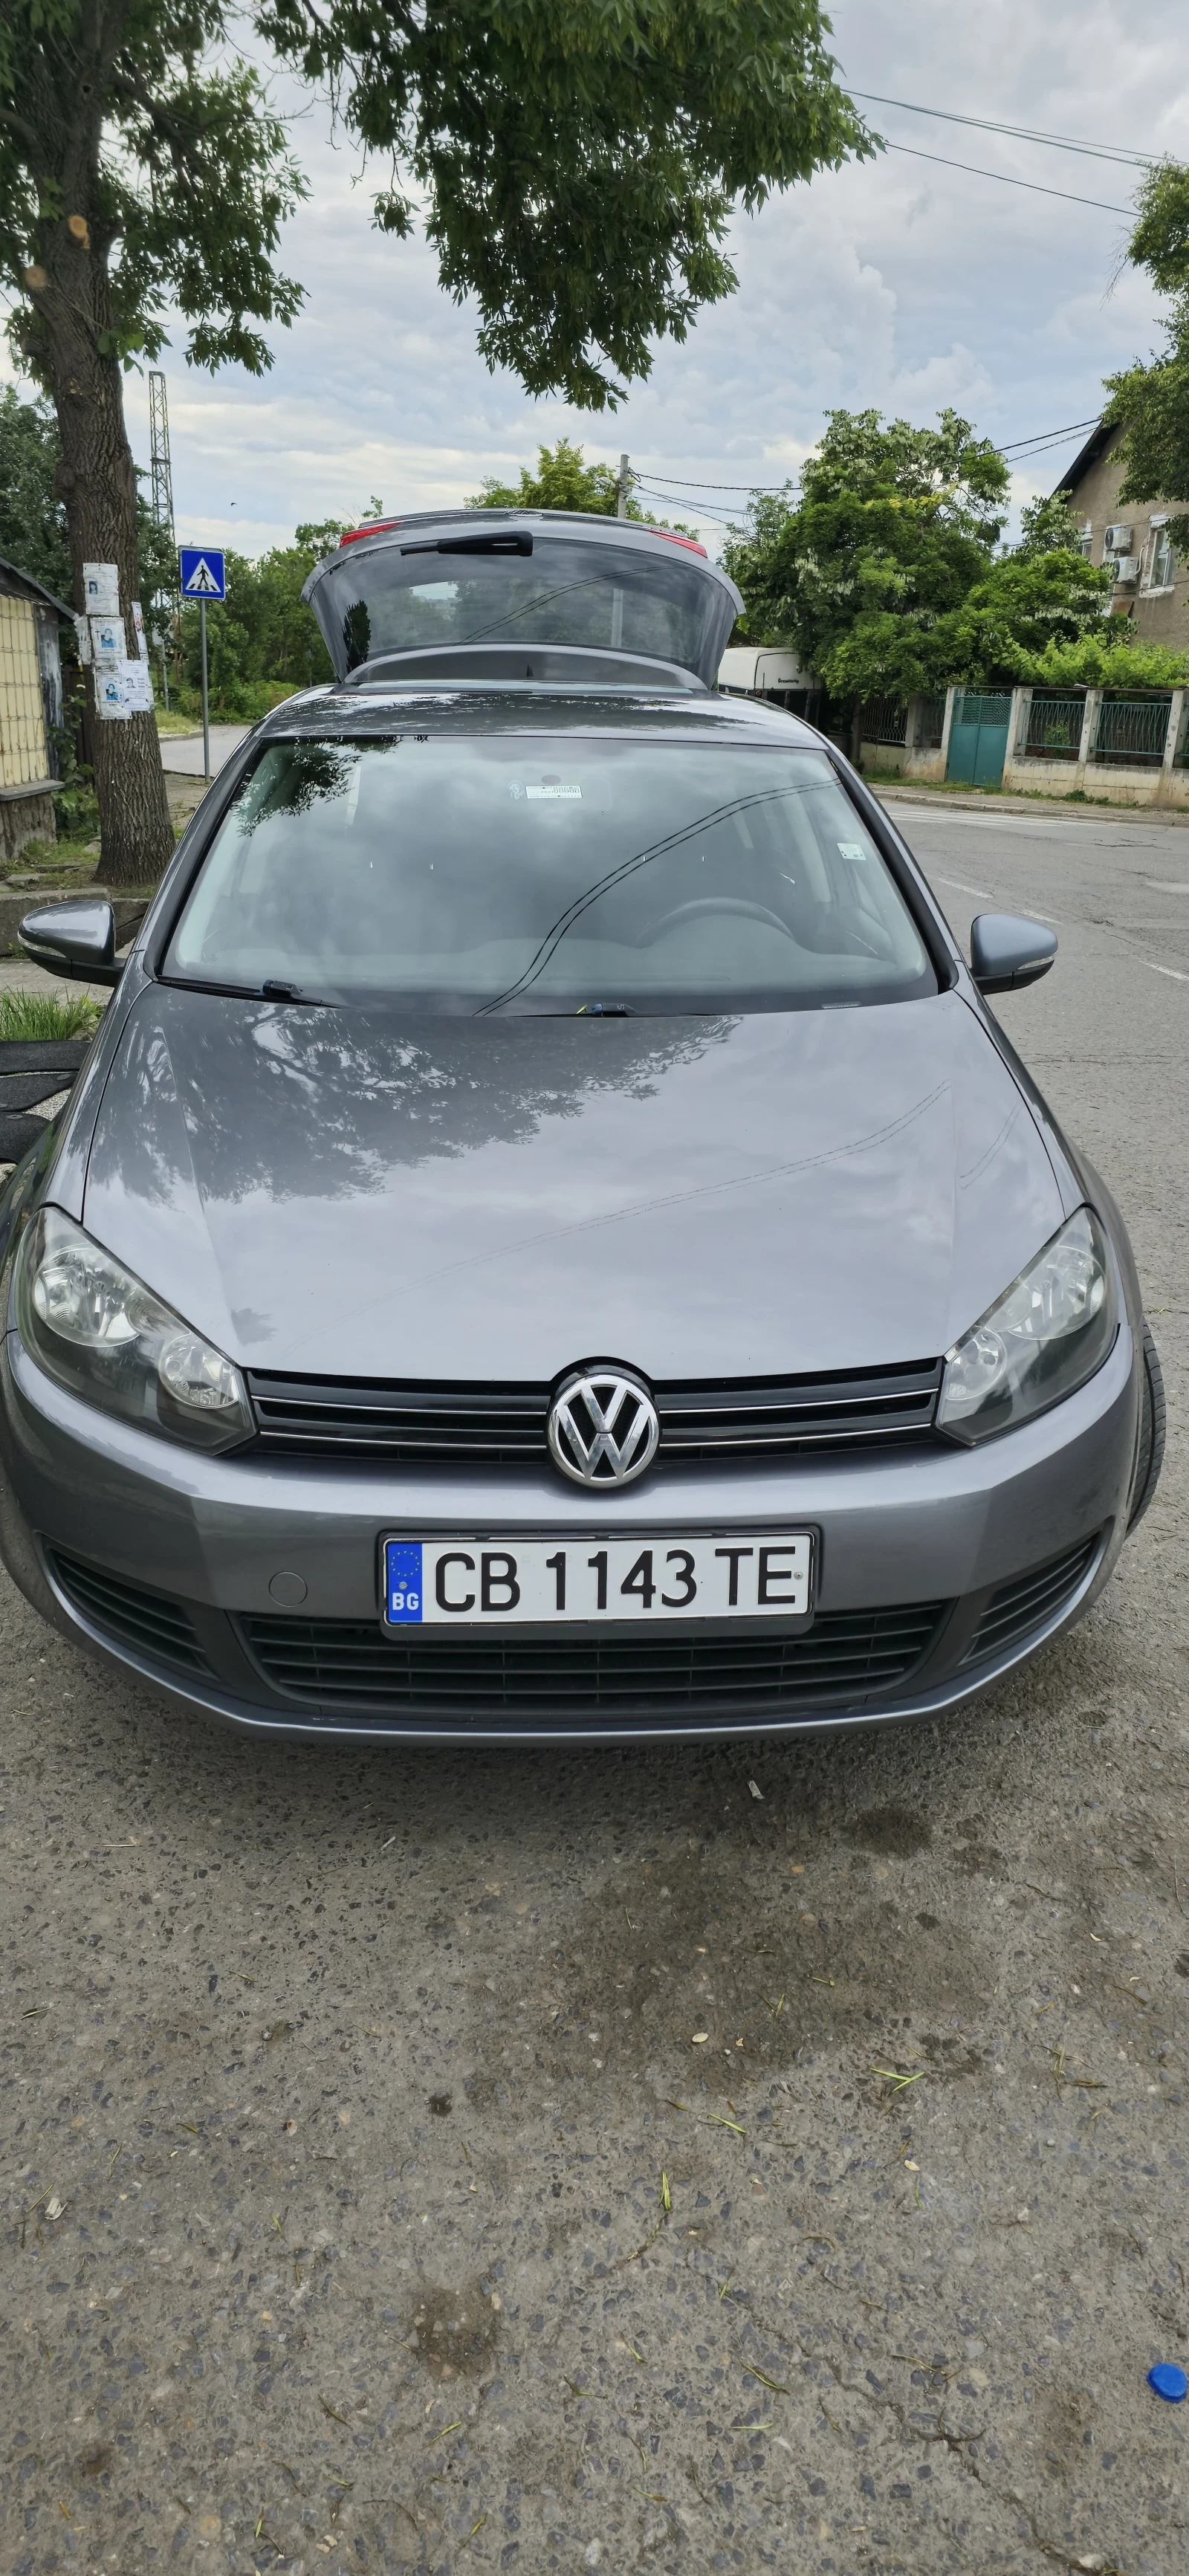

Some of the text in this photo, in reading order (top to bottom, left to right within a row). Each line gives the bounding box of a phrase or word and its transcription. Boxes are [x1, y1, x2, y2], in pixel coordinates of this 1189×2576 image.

[554, 1379, 655, 1482] VW
[391, 1592, 420, 1611] BG
[435, 1546, 796, 1613] CB 1143 TE
